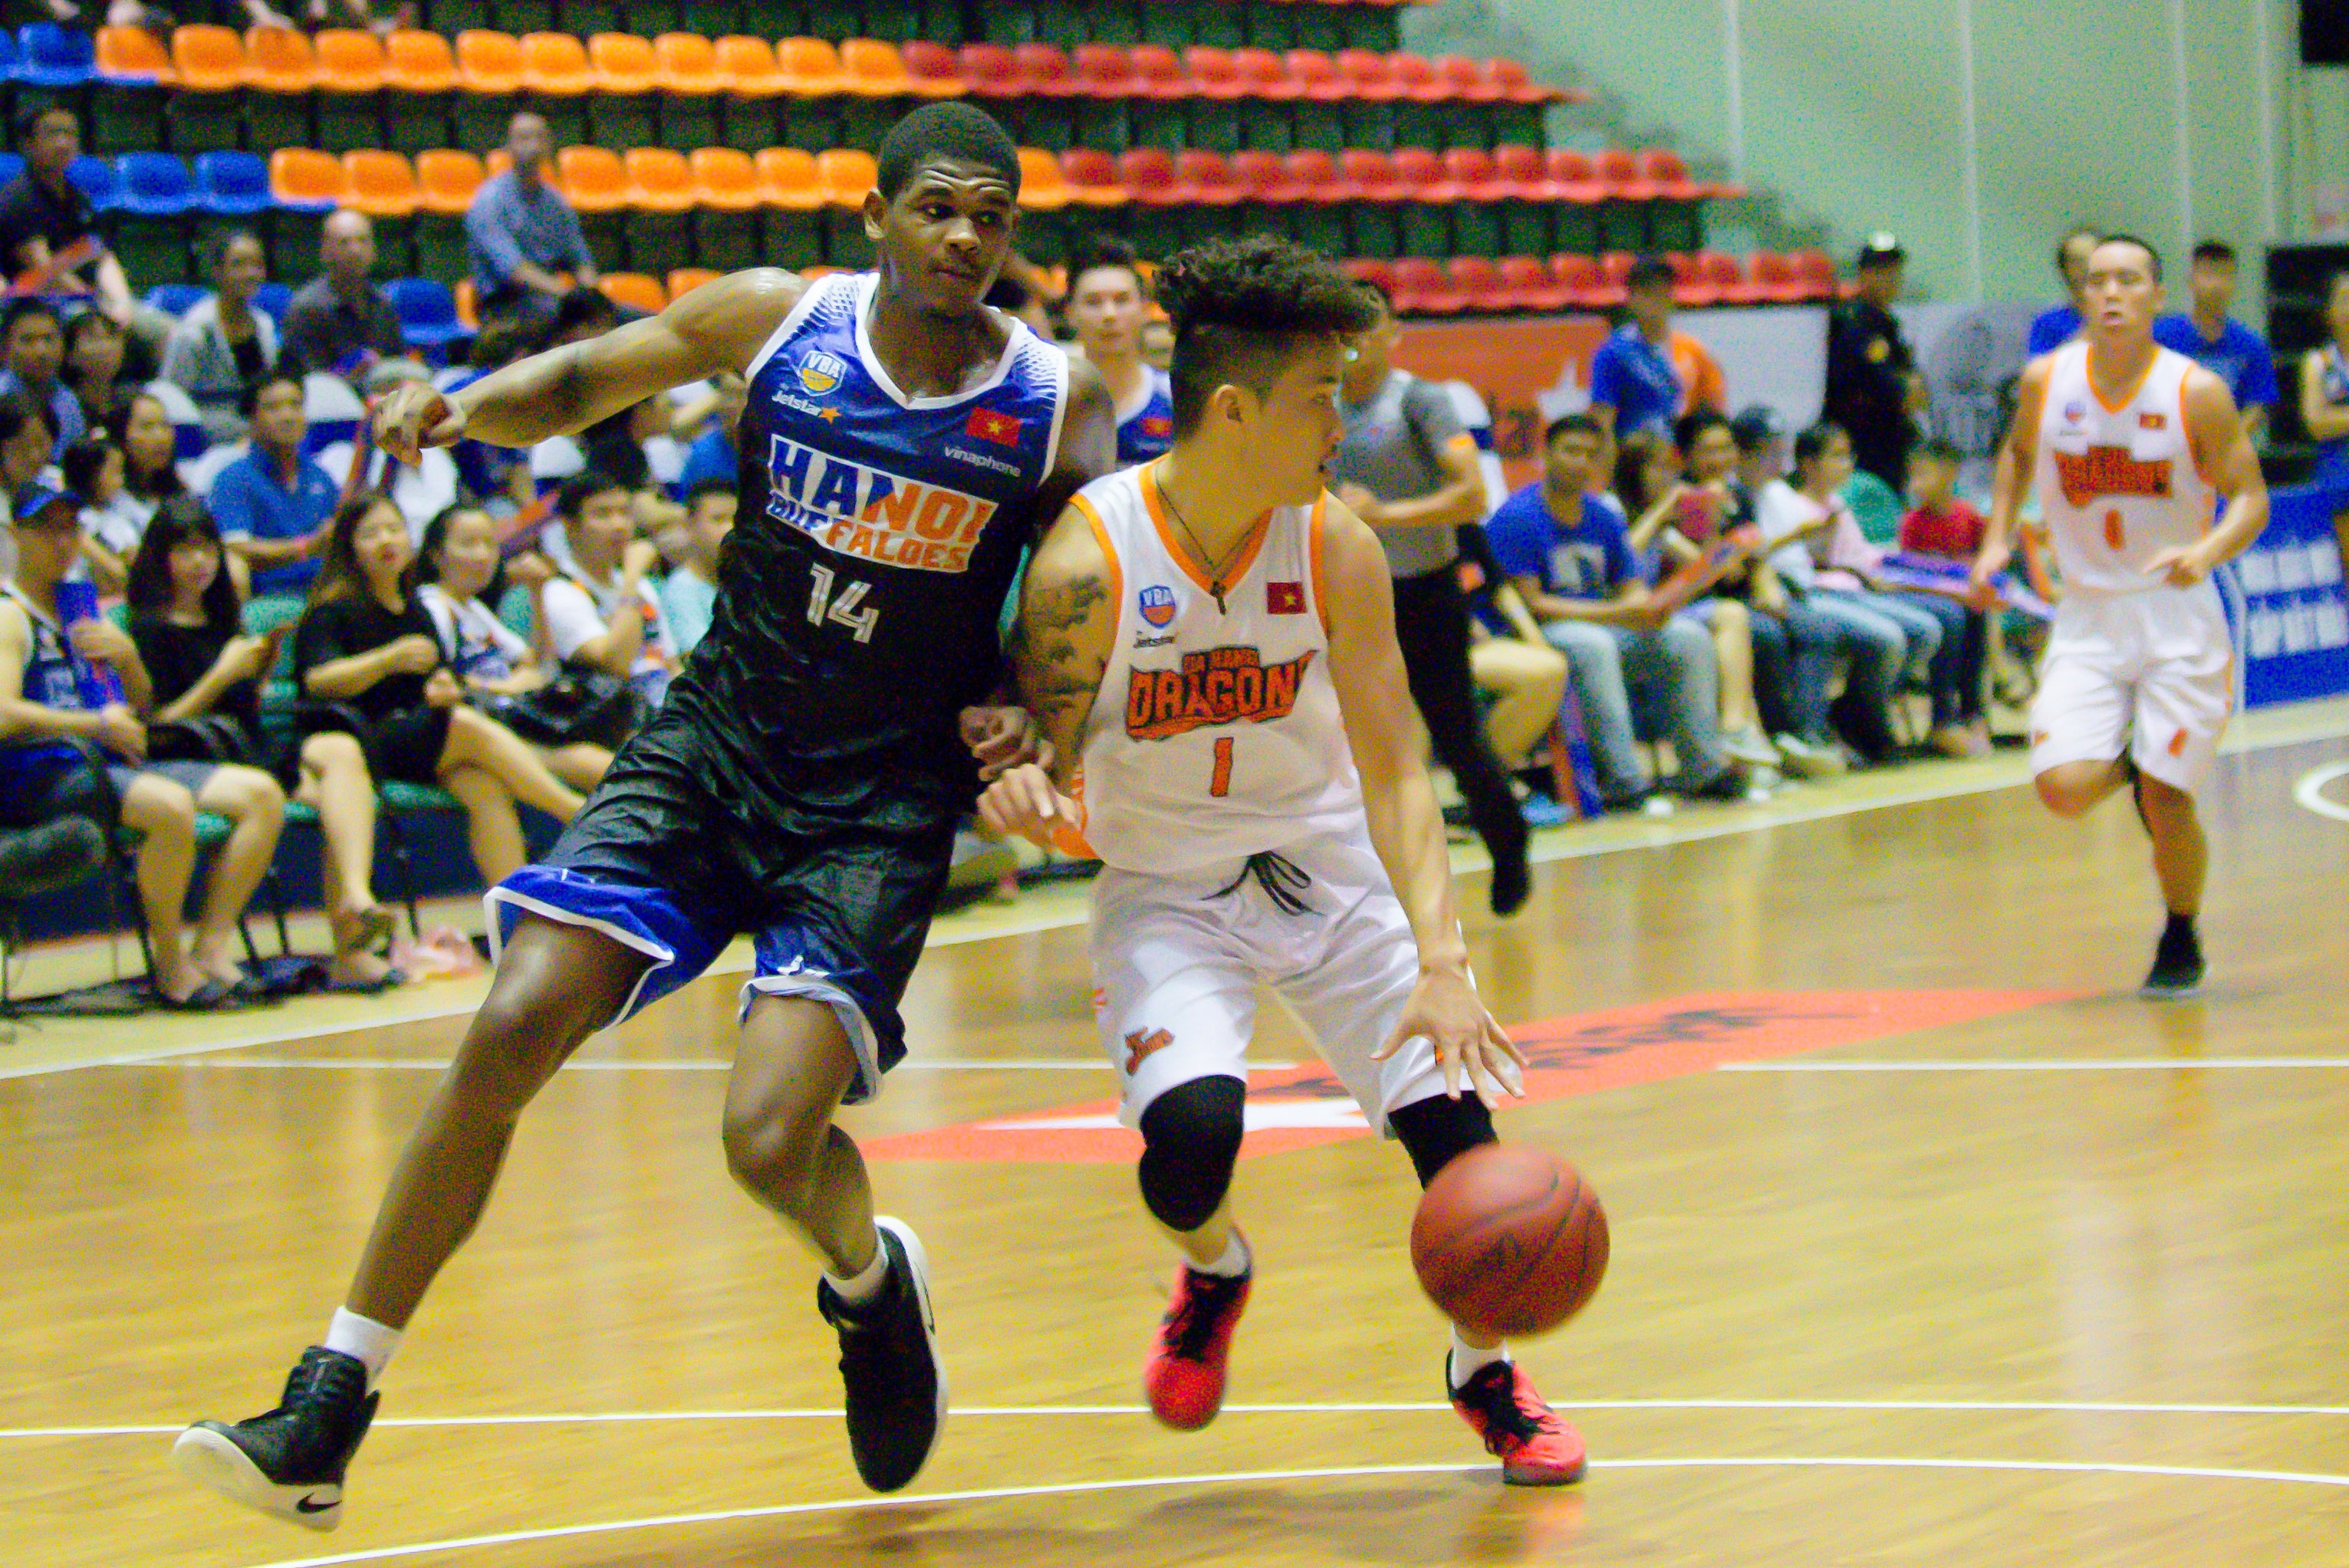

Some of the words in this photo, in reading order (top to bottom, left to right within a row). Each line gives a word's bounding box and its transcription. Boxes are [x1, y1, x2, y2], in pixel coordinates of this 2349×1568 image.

[808, 352, 842, 379] VBA
[771, 390, 821, 416] Jetstar
[769, 436, 996, 544] HANOI
[944, 445, 1022, 478] vinaphone
[806, 561, 880, 644] 14
[1127, 652, 1314, 728] DRAGON
[1210, 736, 1234, 797] 1
